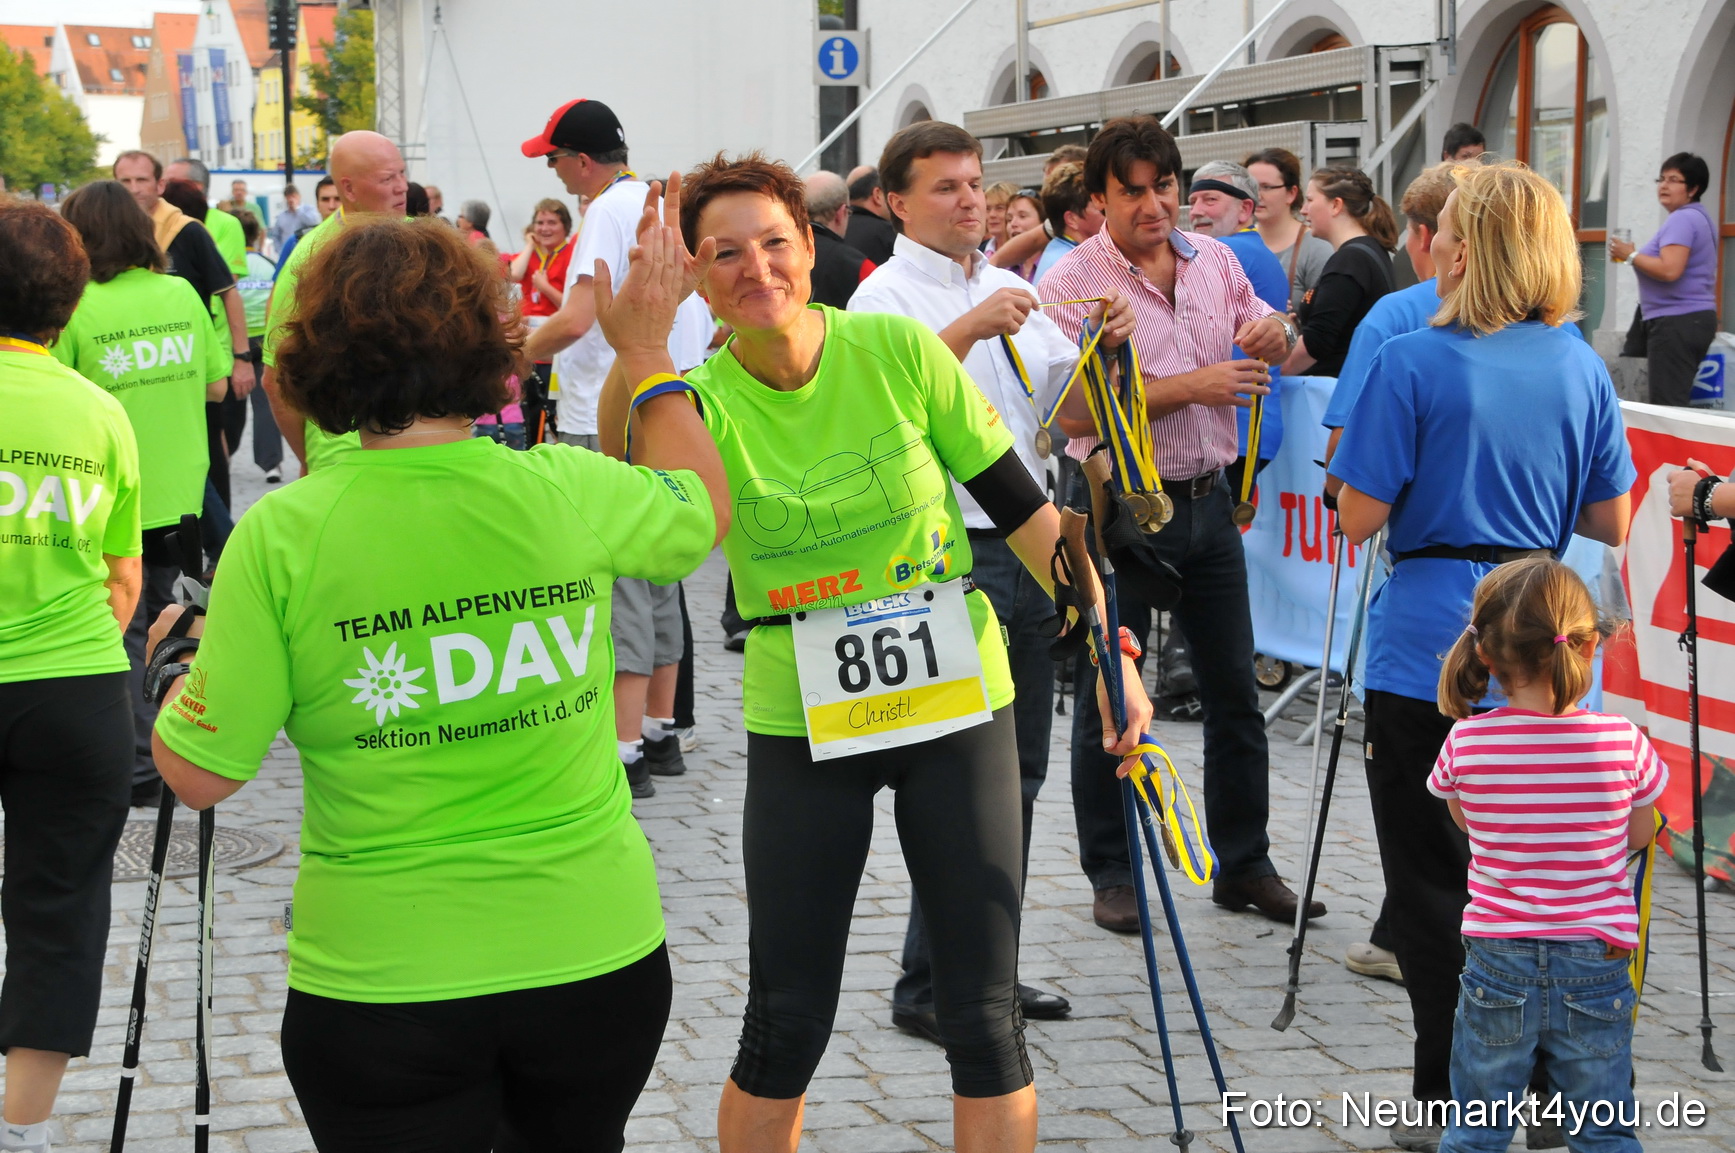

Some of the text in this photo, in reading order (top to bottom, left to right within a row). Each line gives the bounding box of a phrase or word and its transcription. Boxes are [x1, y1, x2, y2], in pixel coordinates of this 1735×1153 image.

[93, 321, 192, 345] TEAM ALPENVEREIN
[132, 333, 194, 370] DAV
[105, 380, 139, 393] Sektion
[139, 374, 175, 387] Neumarkt
[0, 532, 49, 547] umarkt
[52, 533, 73, 550] i.d.
[750, 490, 945, 562] Gebäude- und Automatisierungstechnik GmbH
[895, 539, 955, 582] Bretschneider
[333, 576, 596, 642] TEAM ALPENVEREIN
[767, 569, 864, 611] MERZ
[770, 594, 845, 615] Reisen
[844, 592, 911, 617] BOCK
[429, 604, 596, 705] DAV
[834, 620, 939, 694] 861
[196, 719, 218, 733] GmbH
[354, 727, 431, 750] Sektion
[437, 709, 539, 744] Neumarkt
[542, 700, 571, 724] i.d.
[848, 696, 918, 730] Christl
[138, 870, 161, 968] trainer
